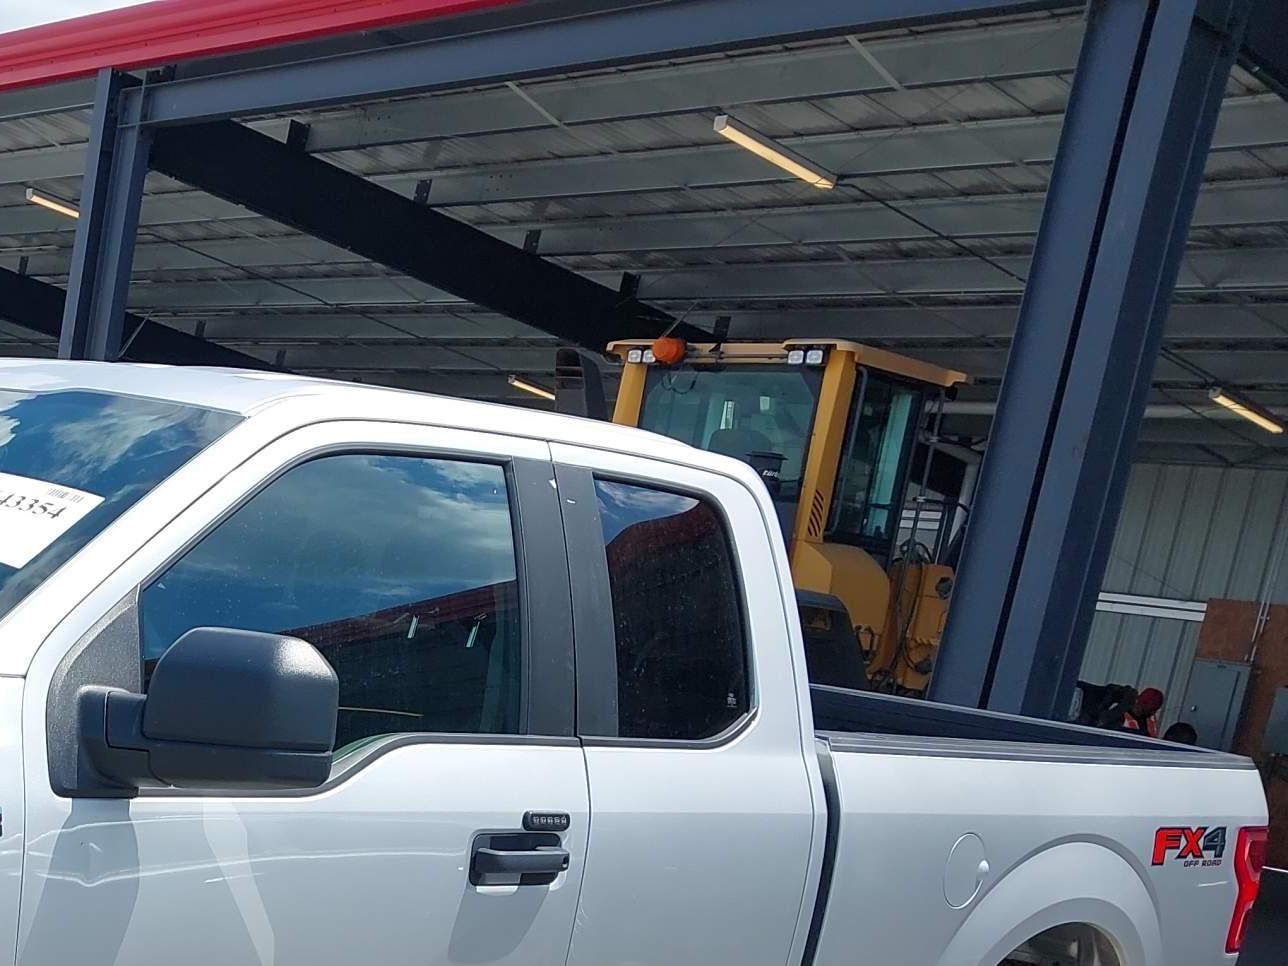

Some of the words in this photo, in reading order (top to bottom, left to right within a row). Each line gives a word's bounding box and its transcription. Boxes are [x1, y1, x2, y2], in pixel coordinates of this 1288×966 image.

[1151, 825, 1227, 867] FX4
[1183, 860, 1199, 868] OFF
[1201, 859, 1222, 867] ROAD
